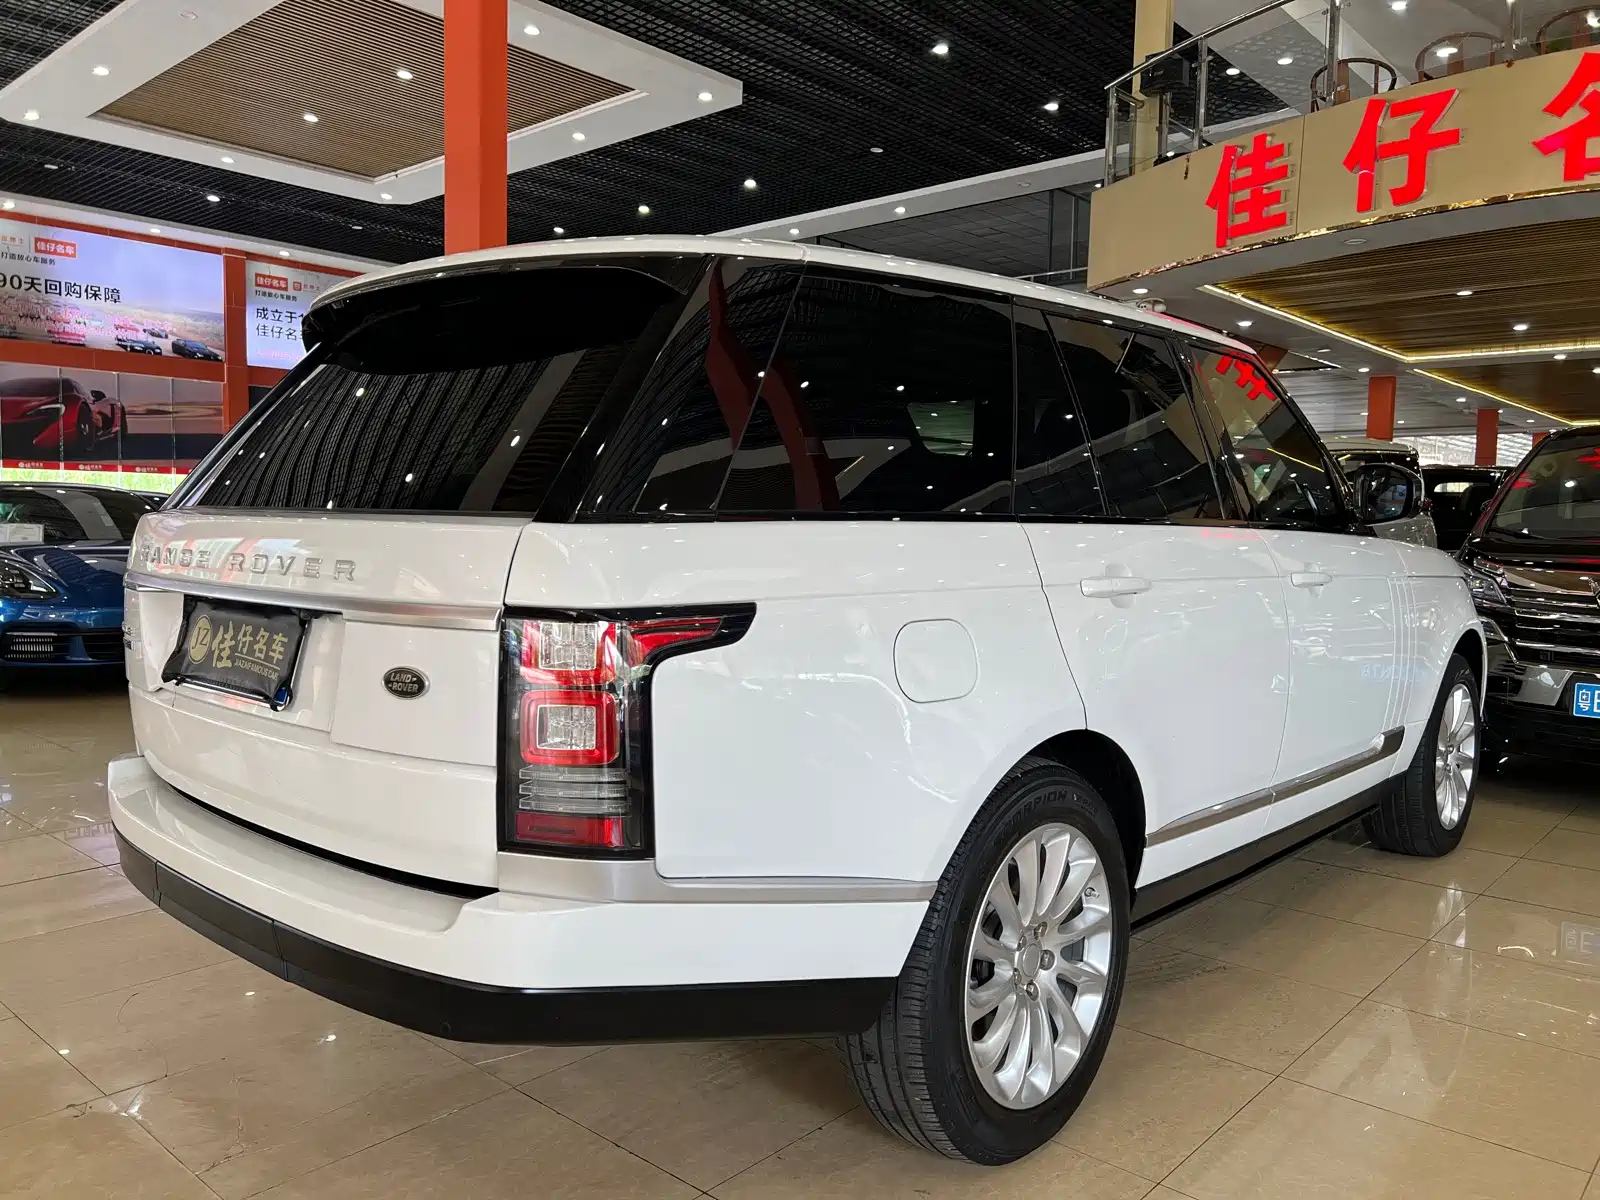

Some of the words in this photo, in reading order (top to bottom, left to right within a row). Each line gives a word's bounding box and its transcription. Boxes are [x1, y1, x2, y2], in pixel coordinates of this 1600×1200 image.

[256, 307, 303, 324] 成立于
[256, 323, 303, 341] 佳仔名
[140, 546, 211, 569] RANGE
[228, 553, 356, 581] ROVER
[211, 620, 289, 668] 佳仔名车
[390, 672, 412, 683] LAND
[392, 682, 419, 692] ROVER
